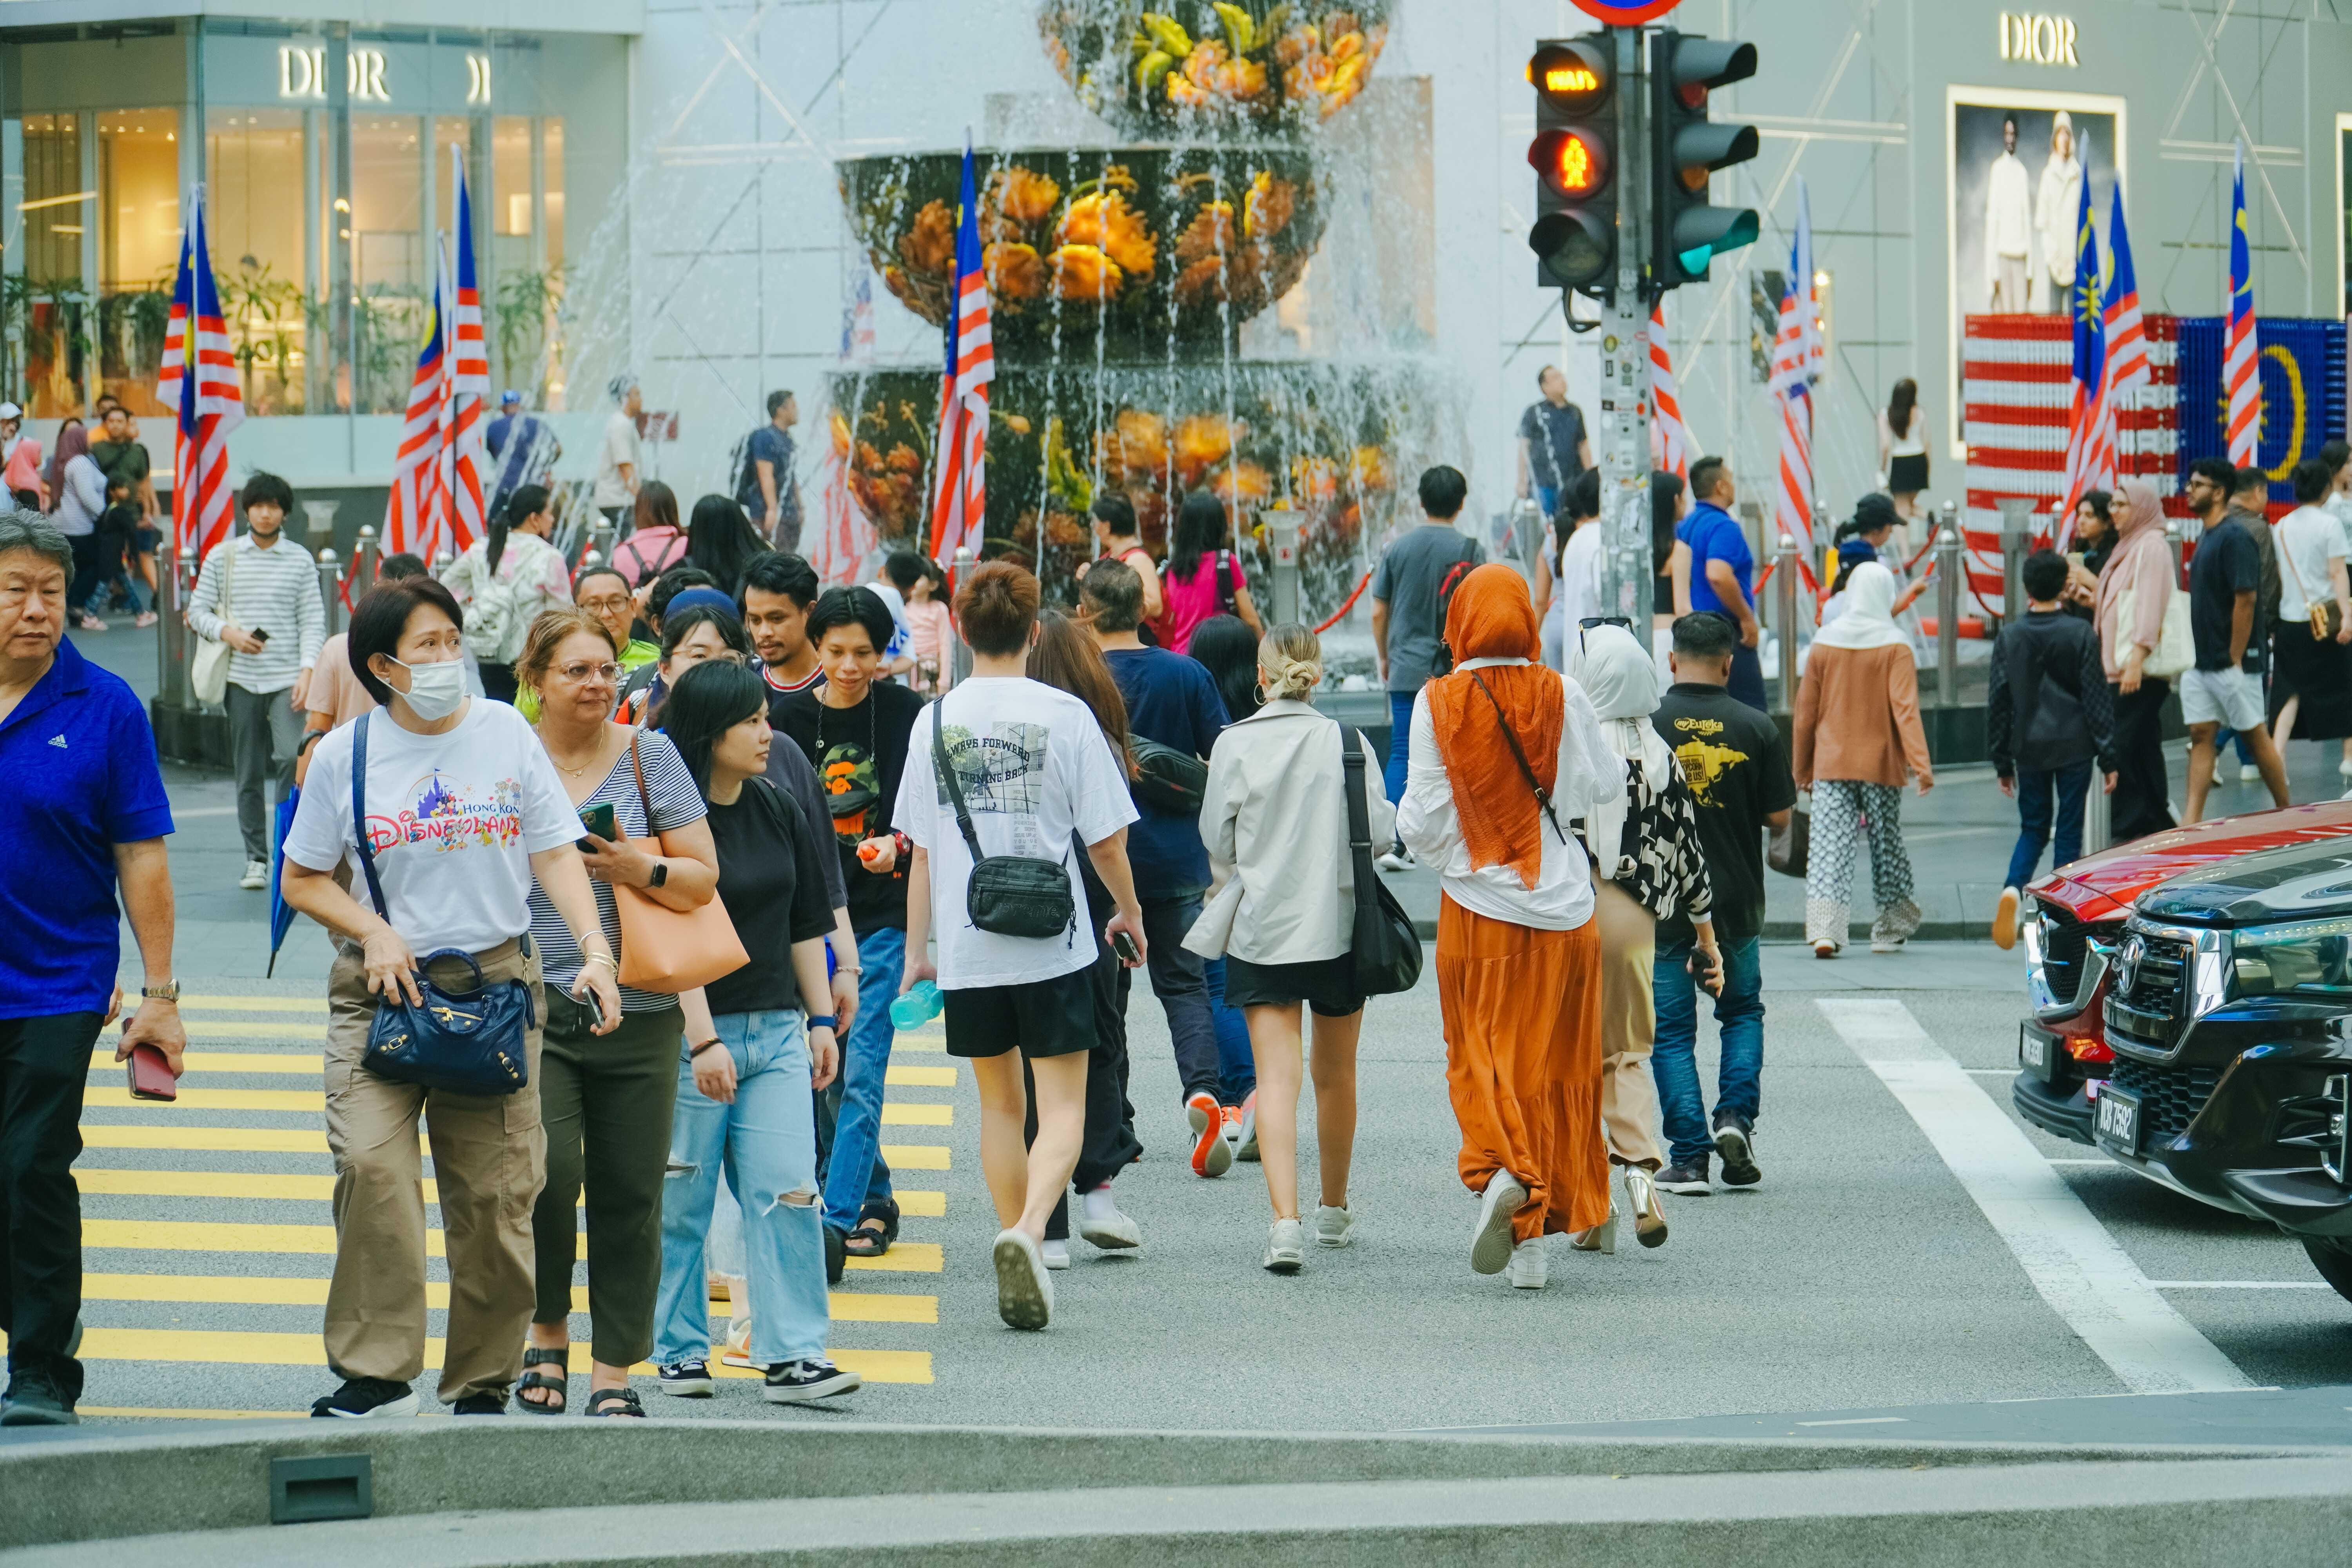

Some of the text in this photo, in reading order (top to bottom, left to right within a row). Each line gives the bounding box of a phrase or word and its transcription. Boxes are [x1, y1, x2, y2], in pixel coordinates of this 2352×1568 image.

[2000, 12, 2079, 67] DIOR
[48, 740, 68, 749] adidas
[946, 738, 1030, 762] LWAYS FORWARD
[1005, 764, 1029, 781] BACK
[463, 803, 519, 814] HONG KON
[2112, 1102, 2132, 1140] 7592
